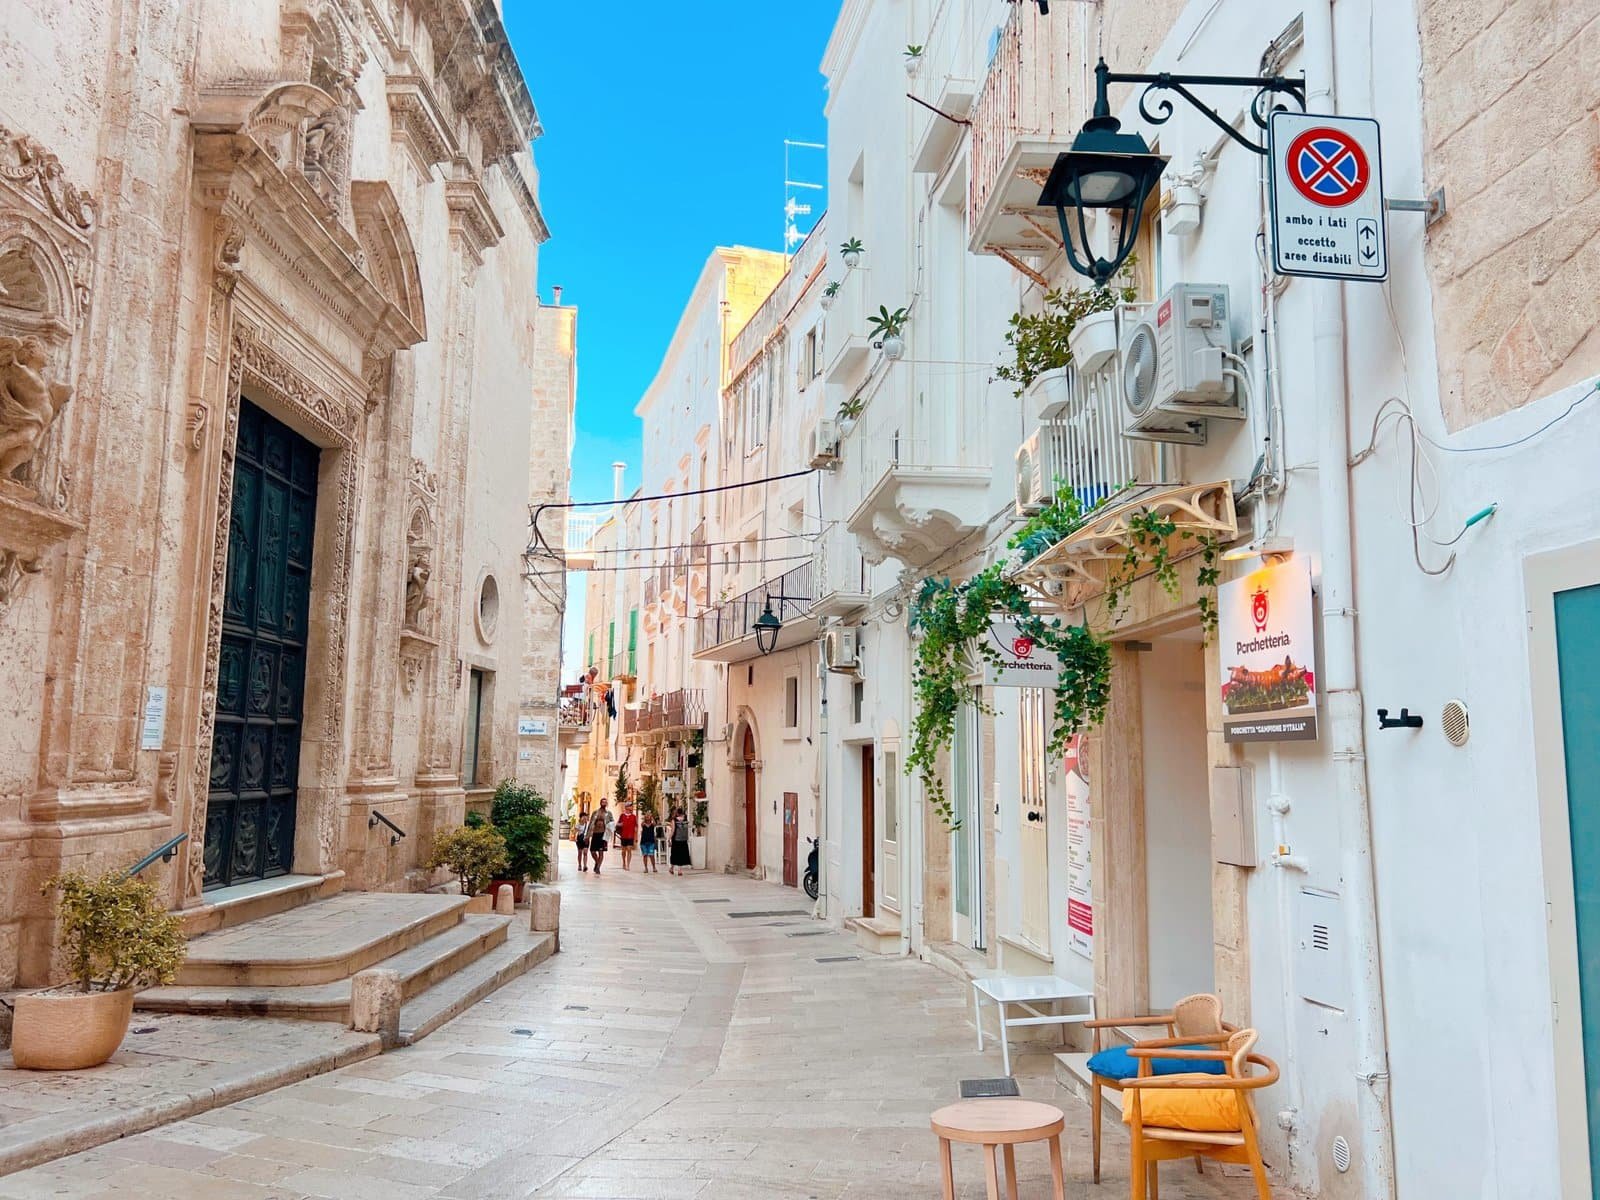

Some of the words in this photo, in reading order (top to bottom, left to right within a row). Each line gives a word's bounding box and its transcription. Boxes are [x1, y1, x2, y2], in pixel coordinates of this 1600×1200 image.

[1286, 215, 1313, 225] ambo
[1319, 215, 1322, 226] i
[1328, 216, 1347, 228] lati
[1298, 237, 1336, 248] eccetto
[1285, 252, 1306, 261] aree
[1313, 252, 1352, 265] disabili
[1236, 631, 1290, 655] Porchetteria
